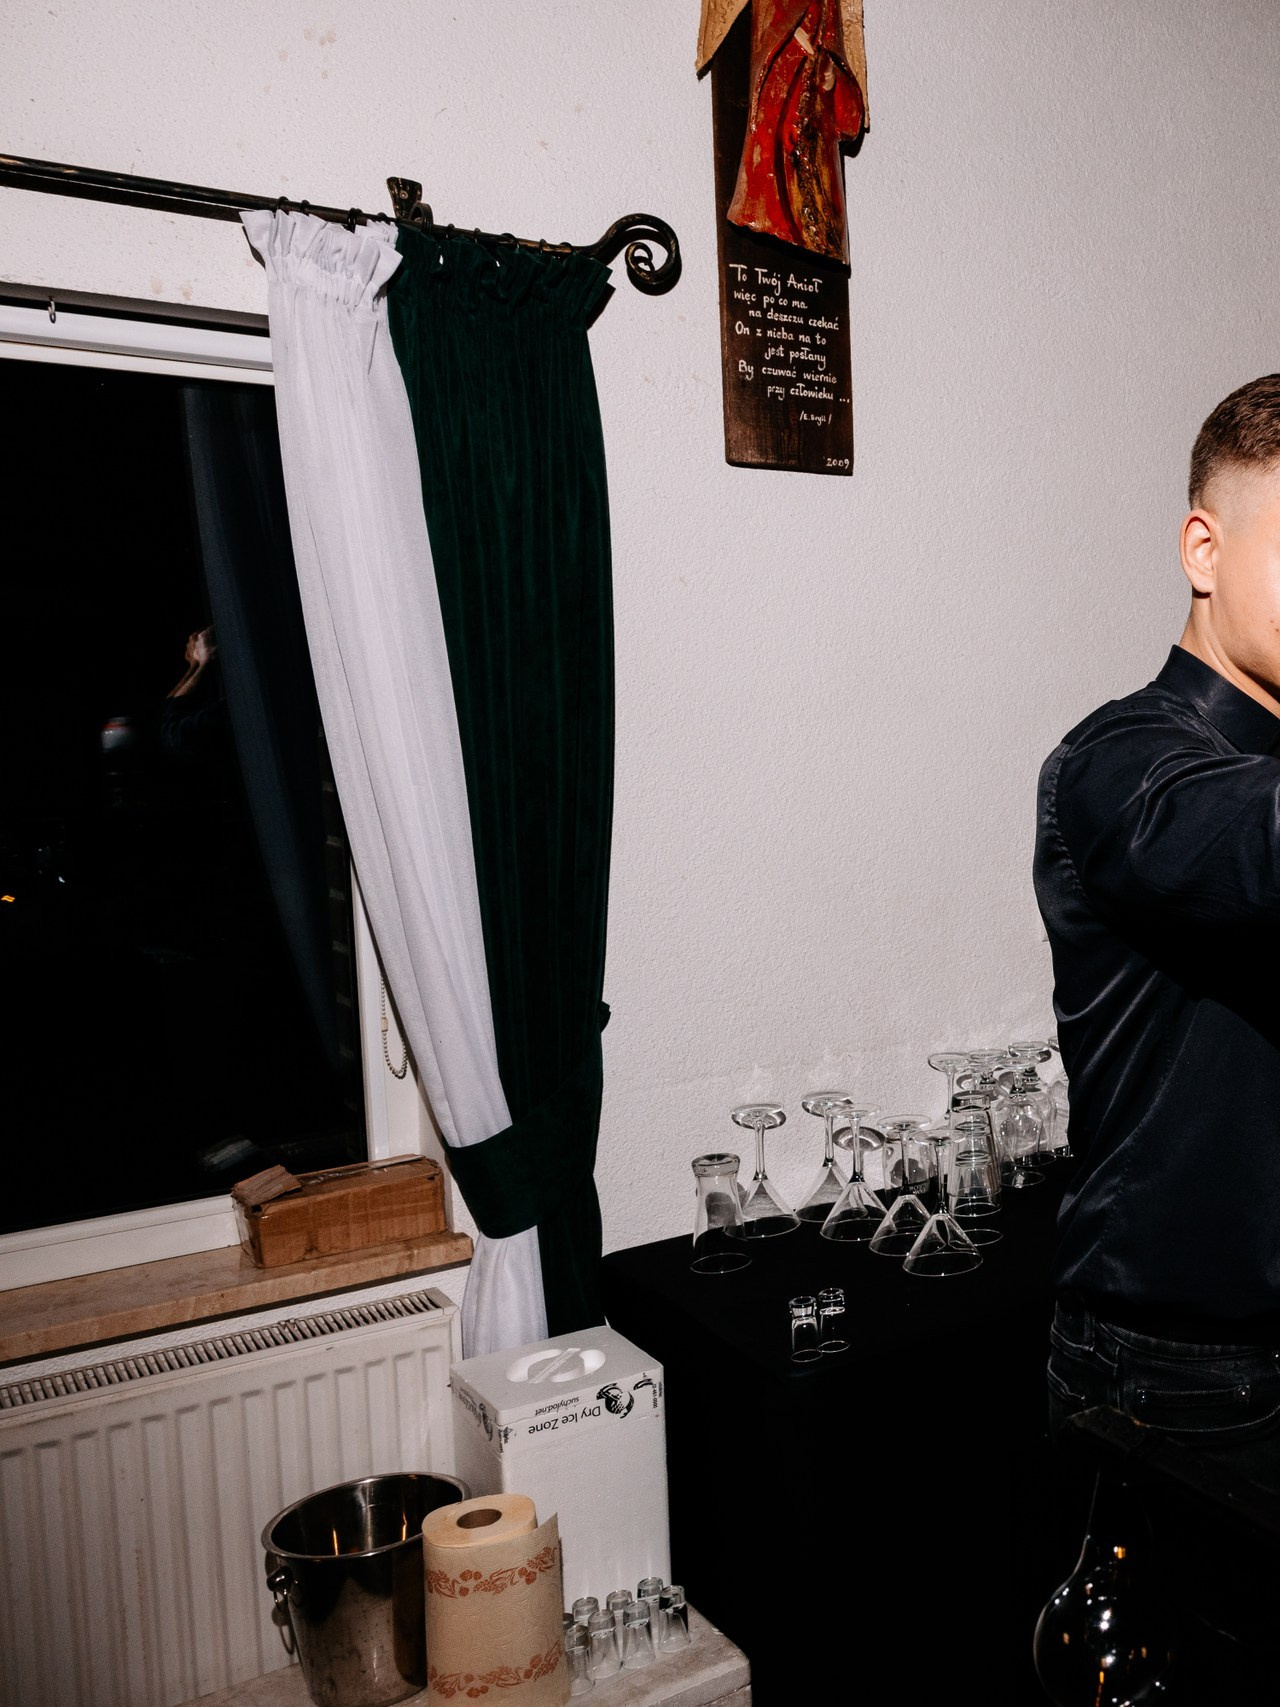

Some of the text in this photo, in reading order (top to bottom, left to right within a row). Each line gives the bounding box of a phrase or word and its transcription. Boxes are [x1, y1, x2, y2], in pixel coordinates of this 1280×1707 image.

[729, 264, 823, 296] To Twój Anioł
[733, 290, 808, 309] więc po co ma
[748, 308, 840, 331] na deszczu czekać
[735, 321, 827, 345] On z nieba na to
[764, 342, 827, 371] jest posłany
[738, 360, 838, 384] By czuwać wiernie
[767, 384, 785, 401] przy
[790, 383, 834, 401] człowieku
[825, 457, 850, 469] 2009
[528, 1405, 601, 1434] Dry Ice Zone
